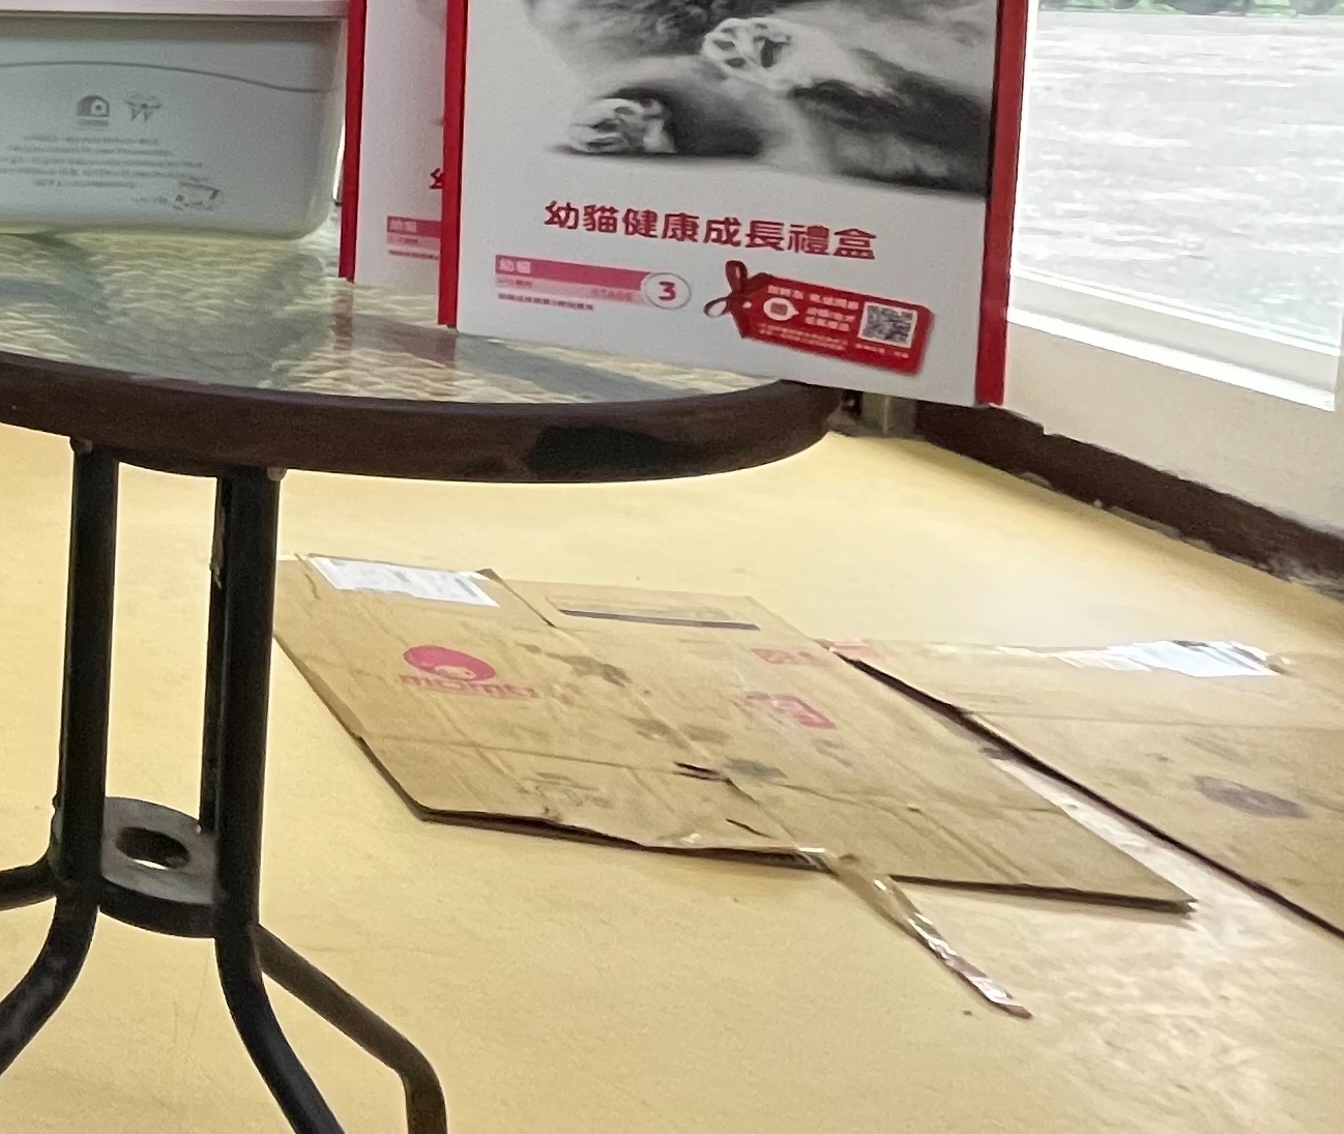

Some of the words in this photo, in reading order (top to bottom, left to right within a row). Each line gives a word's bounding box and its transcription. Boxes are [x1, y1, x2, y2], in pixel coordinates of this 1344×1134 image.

[544, 200, 878, 260] 幼貓健康成長禮盒
[658, 281, 676, 301] 3
